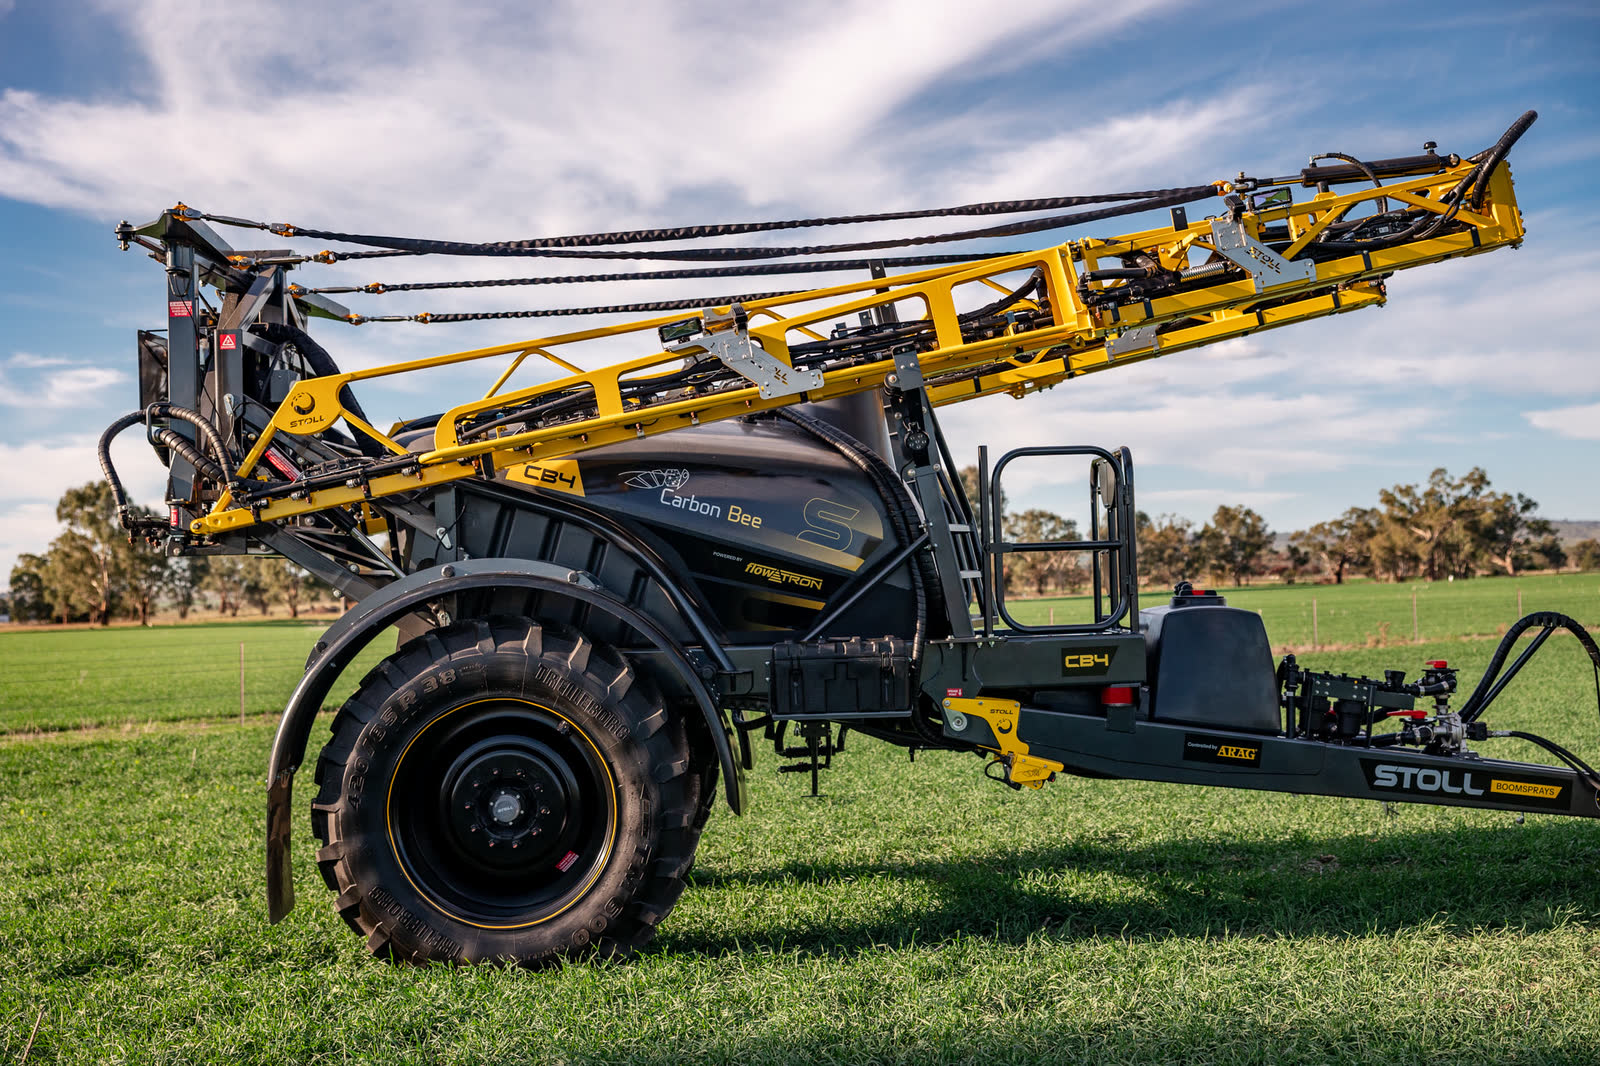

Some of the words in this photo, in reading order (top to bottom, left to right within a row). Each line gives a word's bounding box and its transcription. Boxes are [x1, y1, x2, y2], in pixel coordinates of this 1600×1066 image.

[290, 415, 326, 428] STOLL
[523, 465, 576, 489] CB4
[660, 488, 721, 518] Carbon
[727, 505, 763, 529] Bee
[712, 551, 736, 561] POWERED
[1065, 653, 1109, 668] CB4
[420, 668, 457, 694] 38
[535, 662, 632, 741] TRELLEBORG
[1187, 741, 1211, 750] Controlled
[1211, 744, 1218, 752] by
[1217, 745, 1256, 760] ARAG
[1373, 764, 1485, 796] STOLL
[1496, 782, 1555, 796] BOOMSPRAYS
